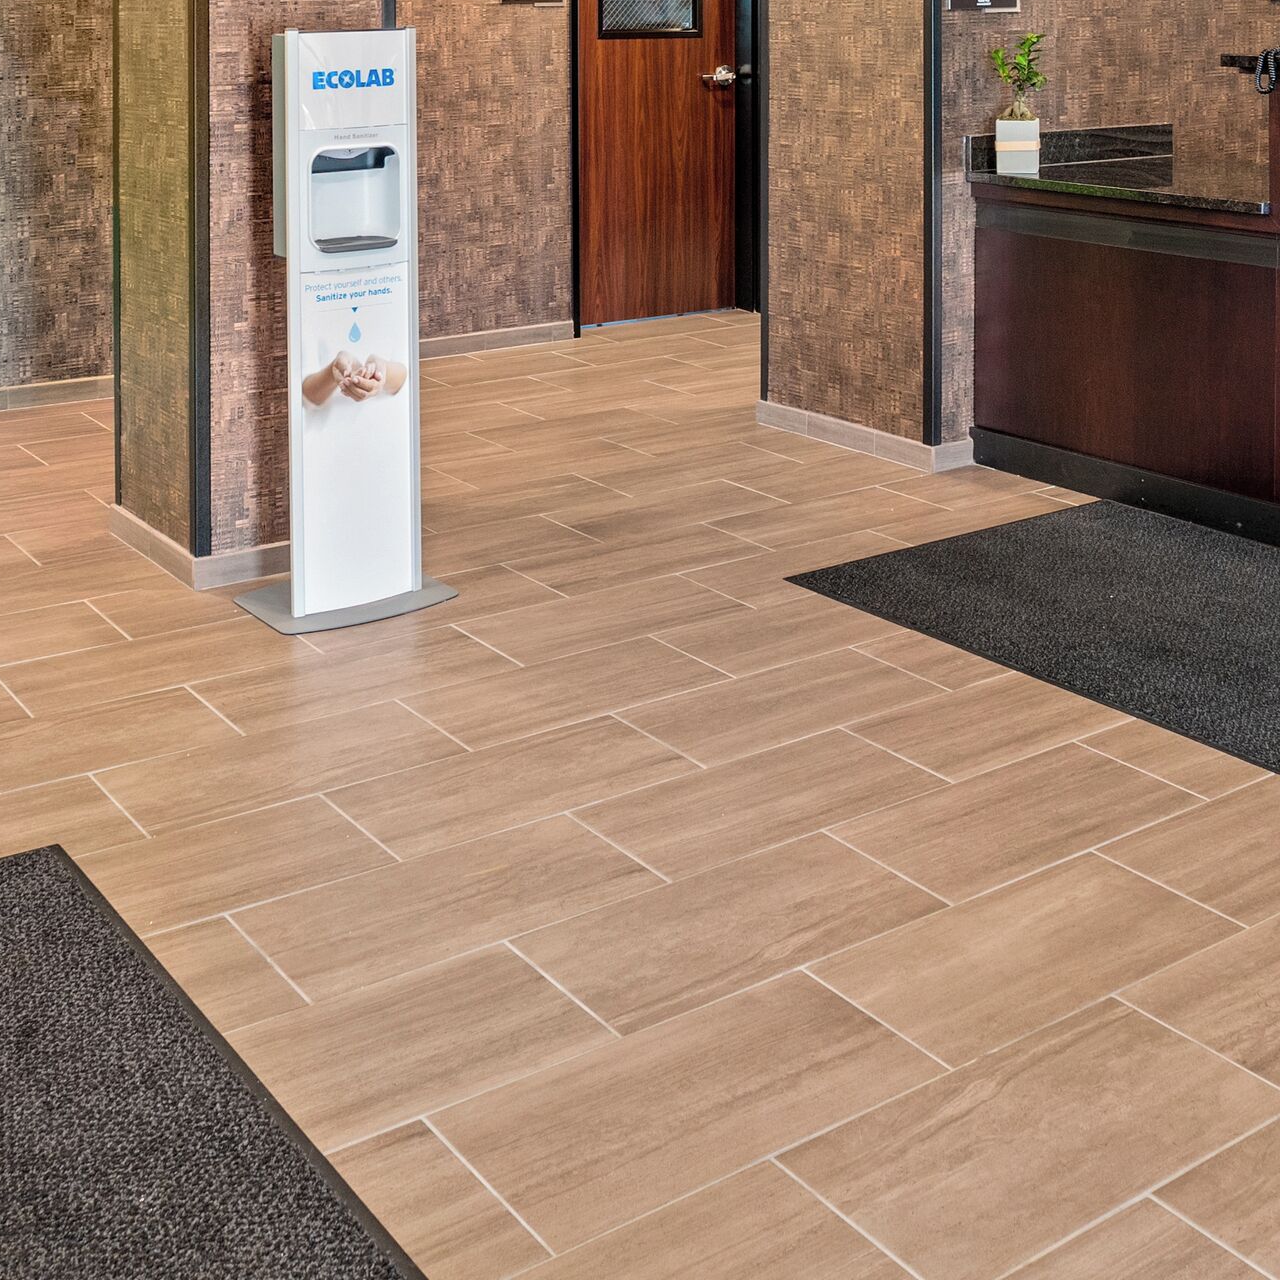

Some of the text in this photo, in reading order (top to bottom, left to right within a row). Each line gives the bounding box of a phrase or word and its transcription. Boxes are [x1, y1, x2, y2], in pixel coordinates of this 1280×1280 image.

[312, 67, 395, 90] ECOLAB
[304, 282, 332, 293] Protect
[333, 278, 362, 292] yourself
[364, 277, 378, 286] and
[315, 287, 393, 303] Sanitize your hands.
